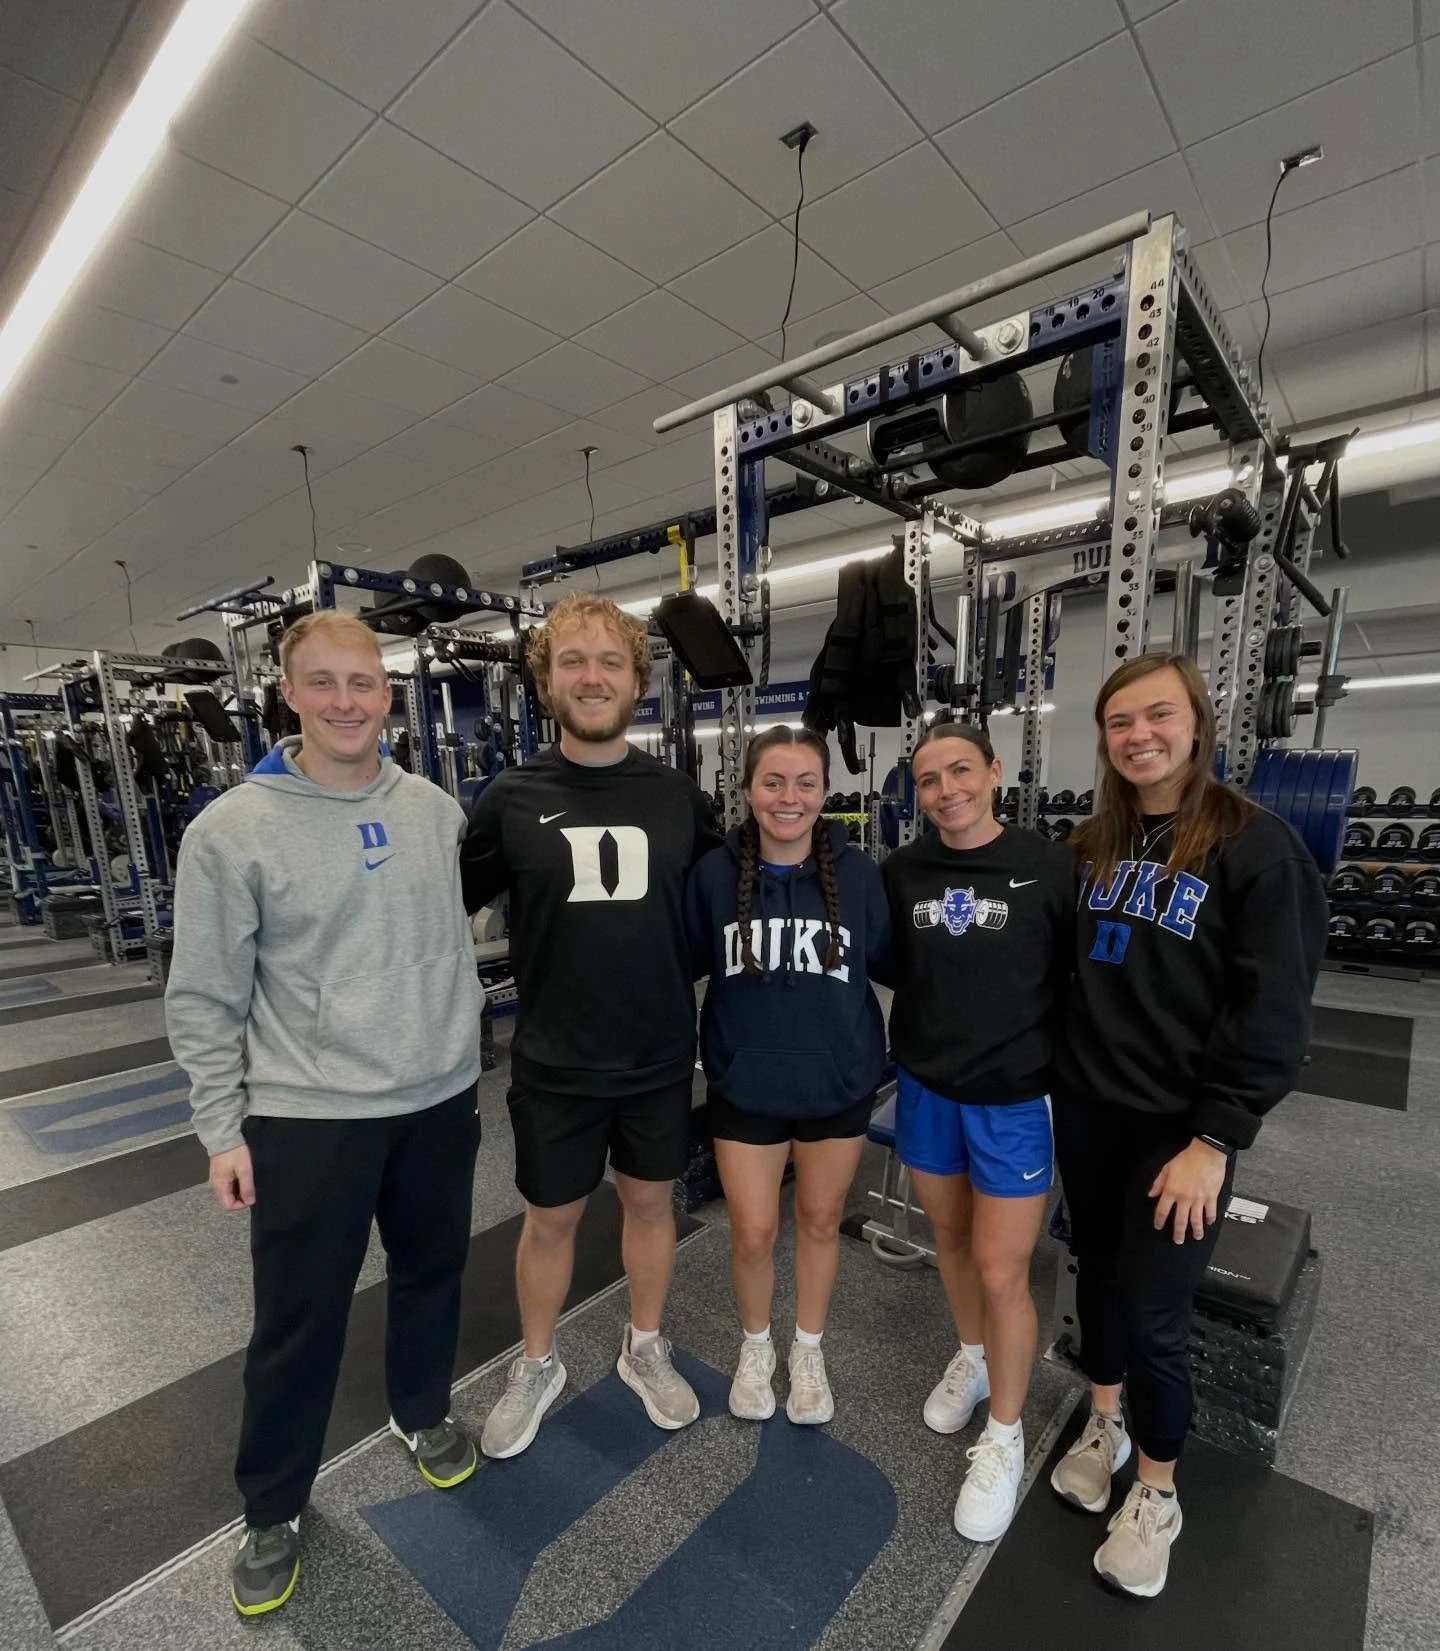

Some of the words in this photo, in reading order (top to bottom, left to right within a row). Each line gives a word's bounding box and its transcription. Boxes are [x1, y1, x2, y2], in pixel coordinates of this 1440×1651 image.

[1150, 278, 1165, 290] 44
[1092, 287, 1105, 300] 20
[1149, 308, 1162, 319] 43
[1146, 337, 1160, 348] 42
[1142, 394, 1156, 404] 40
[1140, 422, 1153, 433] 39
[1073, 545, 1111, 573] DU
[1128, 582, 1140, 592] 33
[754, 692, 796, 705] SWIMMING
[798, 691, 804, 701] &
[692, 701, 715, 712] OWING
[356, 822, 388, 850] D
[560, 825, 649, 903] D
[1088, 920, 1132, 965] D
[723, 918, 850, 983] DUKE
